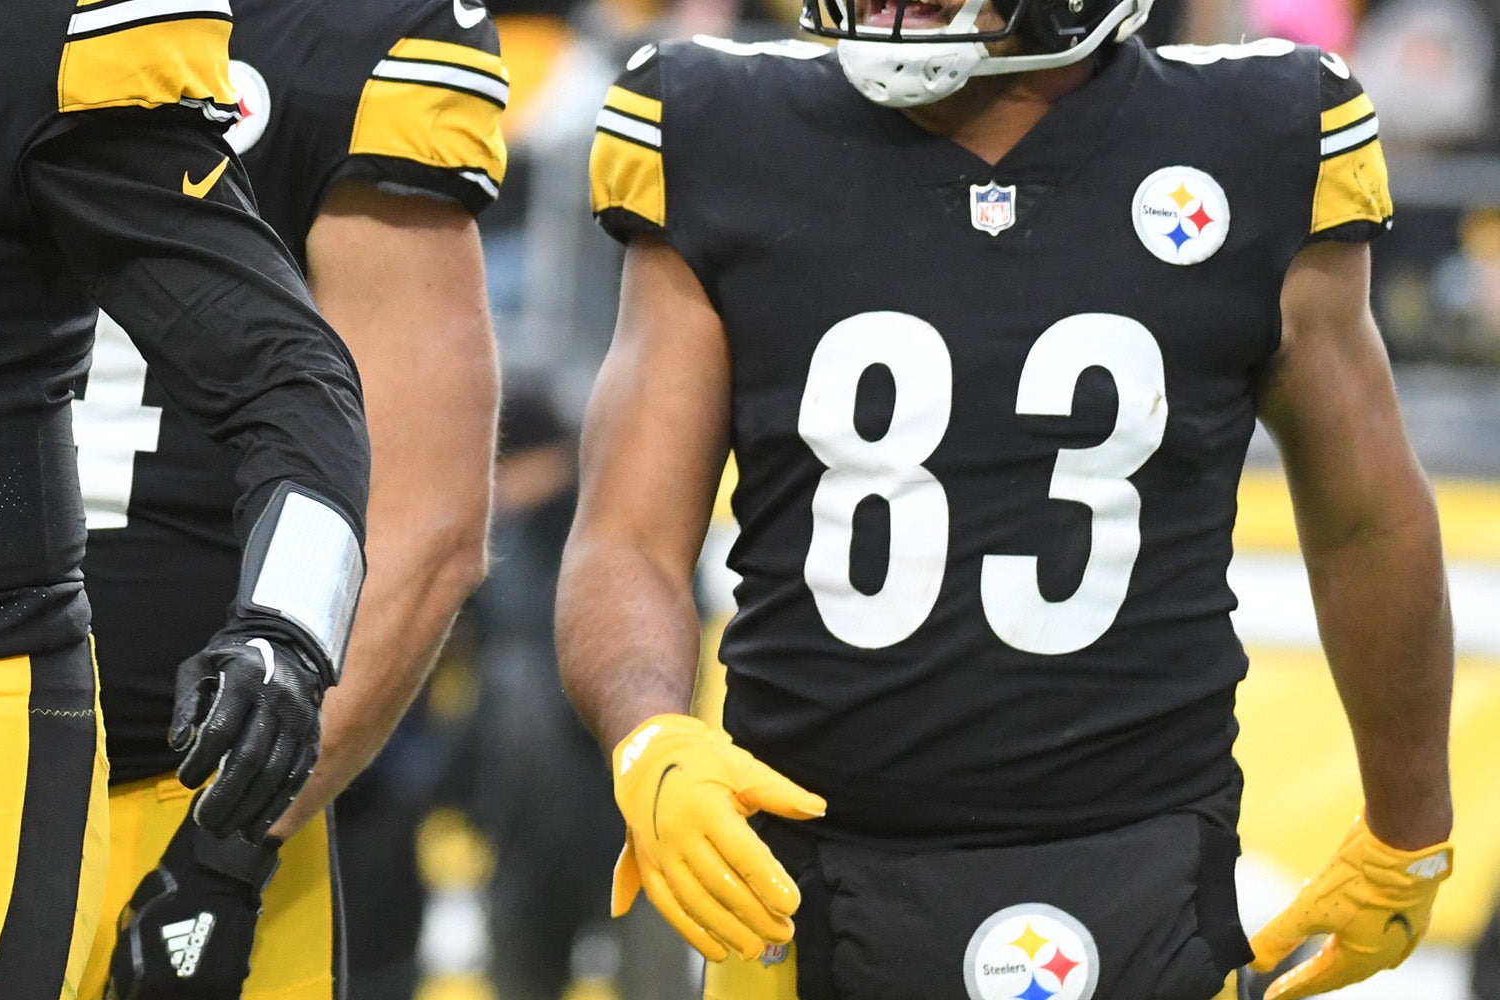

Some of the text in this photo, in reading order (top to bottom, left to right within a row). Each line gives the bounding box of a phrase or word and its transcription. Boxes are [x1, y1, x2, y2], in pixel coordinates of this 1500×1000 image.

[1142, 204, 1178, 219] Steelers
[798, 310, 1169, 656] 83
[982, 962, 1027, 977] Steelers
